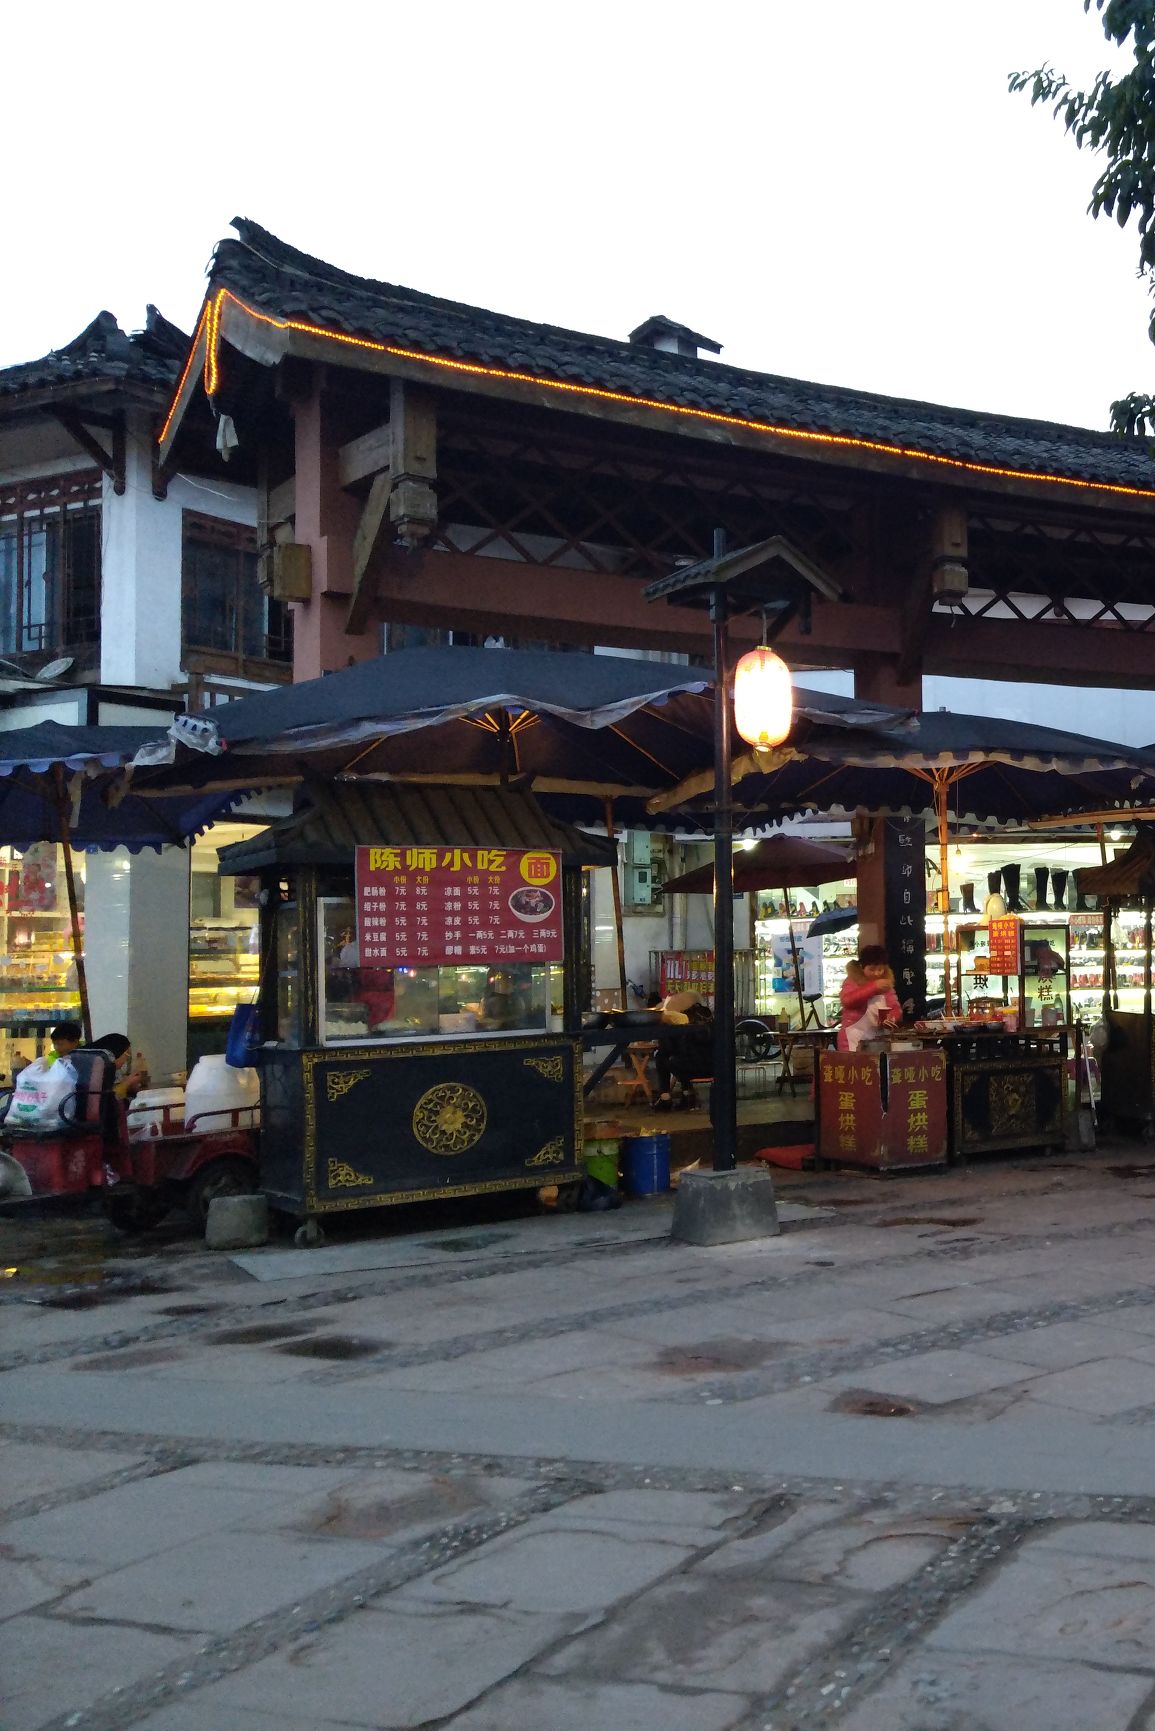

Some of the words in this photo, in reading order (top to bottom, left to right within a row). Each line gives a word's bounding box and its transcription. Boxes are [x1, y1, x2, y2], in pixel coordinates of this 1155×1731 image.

[369, 848, 507, 872] 陈师小吃
[527, 856, 551, 879] 面
[395, 886, 407, 895] 7元
[467, 886, 479, 895] 5元
[488, 886, 500, 895] 7元
[395, 902, 407, 911] 7元
[468, 901, 480, 910] 5元
[488, 901, 500, 910] 7元
[395, 917, 407, 926] 5元
[416, 917, 428, 926] 7元
[468, 916, 480, 925] 5元
[489, 916, 500, 925] 7元
[395, 932, 407, 941] 5元
[416, 932, 428, 941] 7元
[396, 948, 407, 957] 5元
[417, 947, 429, 956] 7元
[838, 1091, 856, 1152] 蛋烘糕
[907, 1090, 928, 1153] 蛋烘糕
